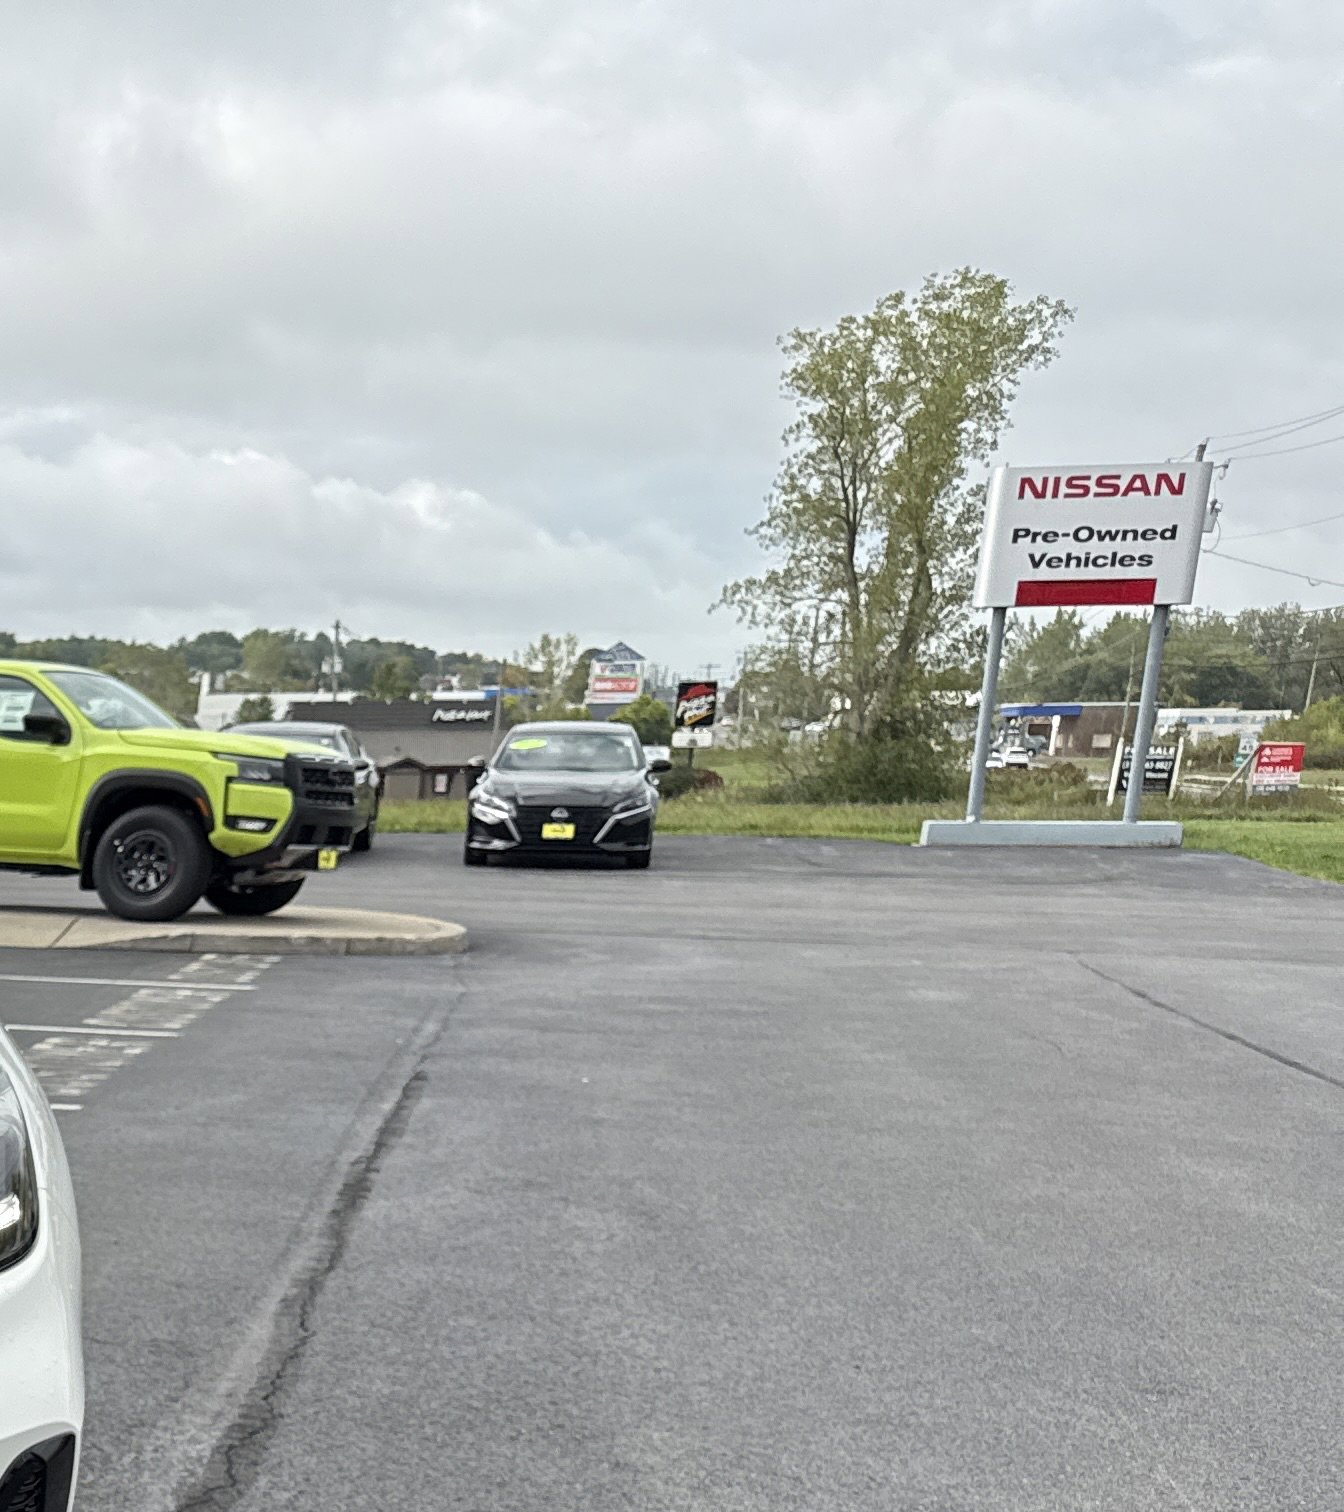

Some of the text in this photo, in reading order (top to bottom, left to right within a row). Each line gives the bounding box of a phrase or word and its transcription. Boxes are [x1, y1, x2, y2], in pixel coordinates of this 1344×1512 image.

[1017, 472, 1187, 500] NISSAN
[1011, 524, 1178, 544] Pre-Owned
[1028, 552, 1154, 570] Vehicles
